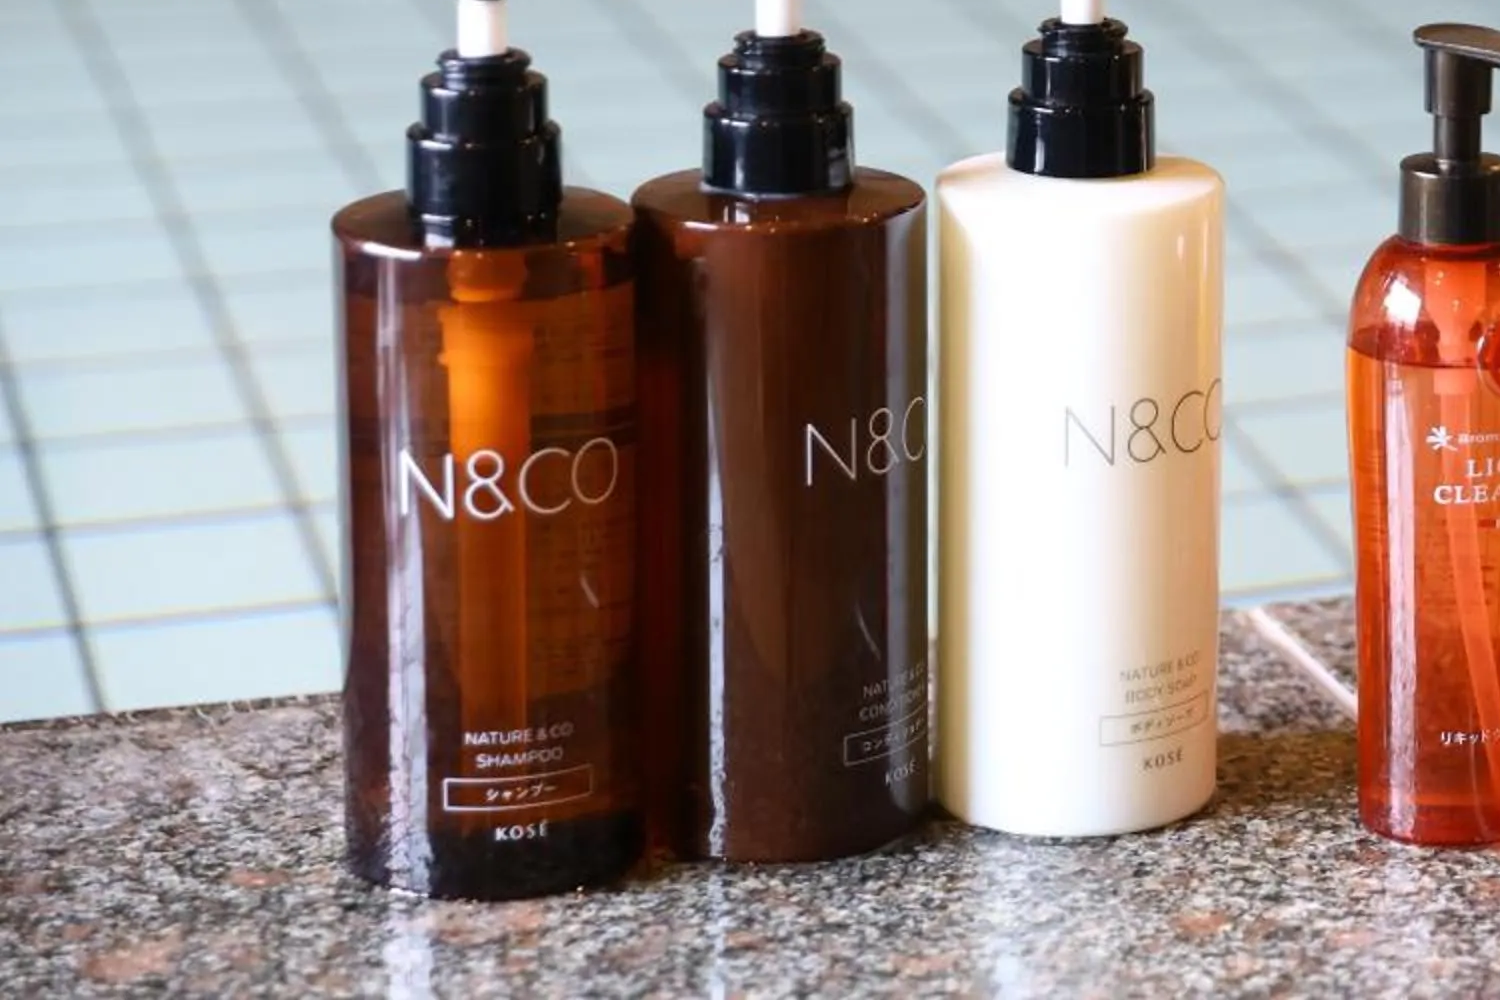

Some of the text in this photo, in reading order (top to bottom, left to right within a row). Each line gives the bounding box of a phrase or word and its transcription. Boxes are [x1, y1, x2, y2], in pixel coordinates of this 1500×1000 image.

[399, 437, 618, 520] N&CO
[464, 721, 575, 746] NATURE & CO
[475, 746, 564, 769] SHAMPOO
